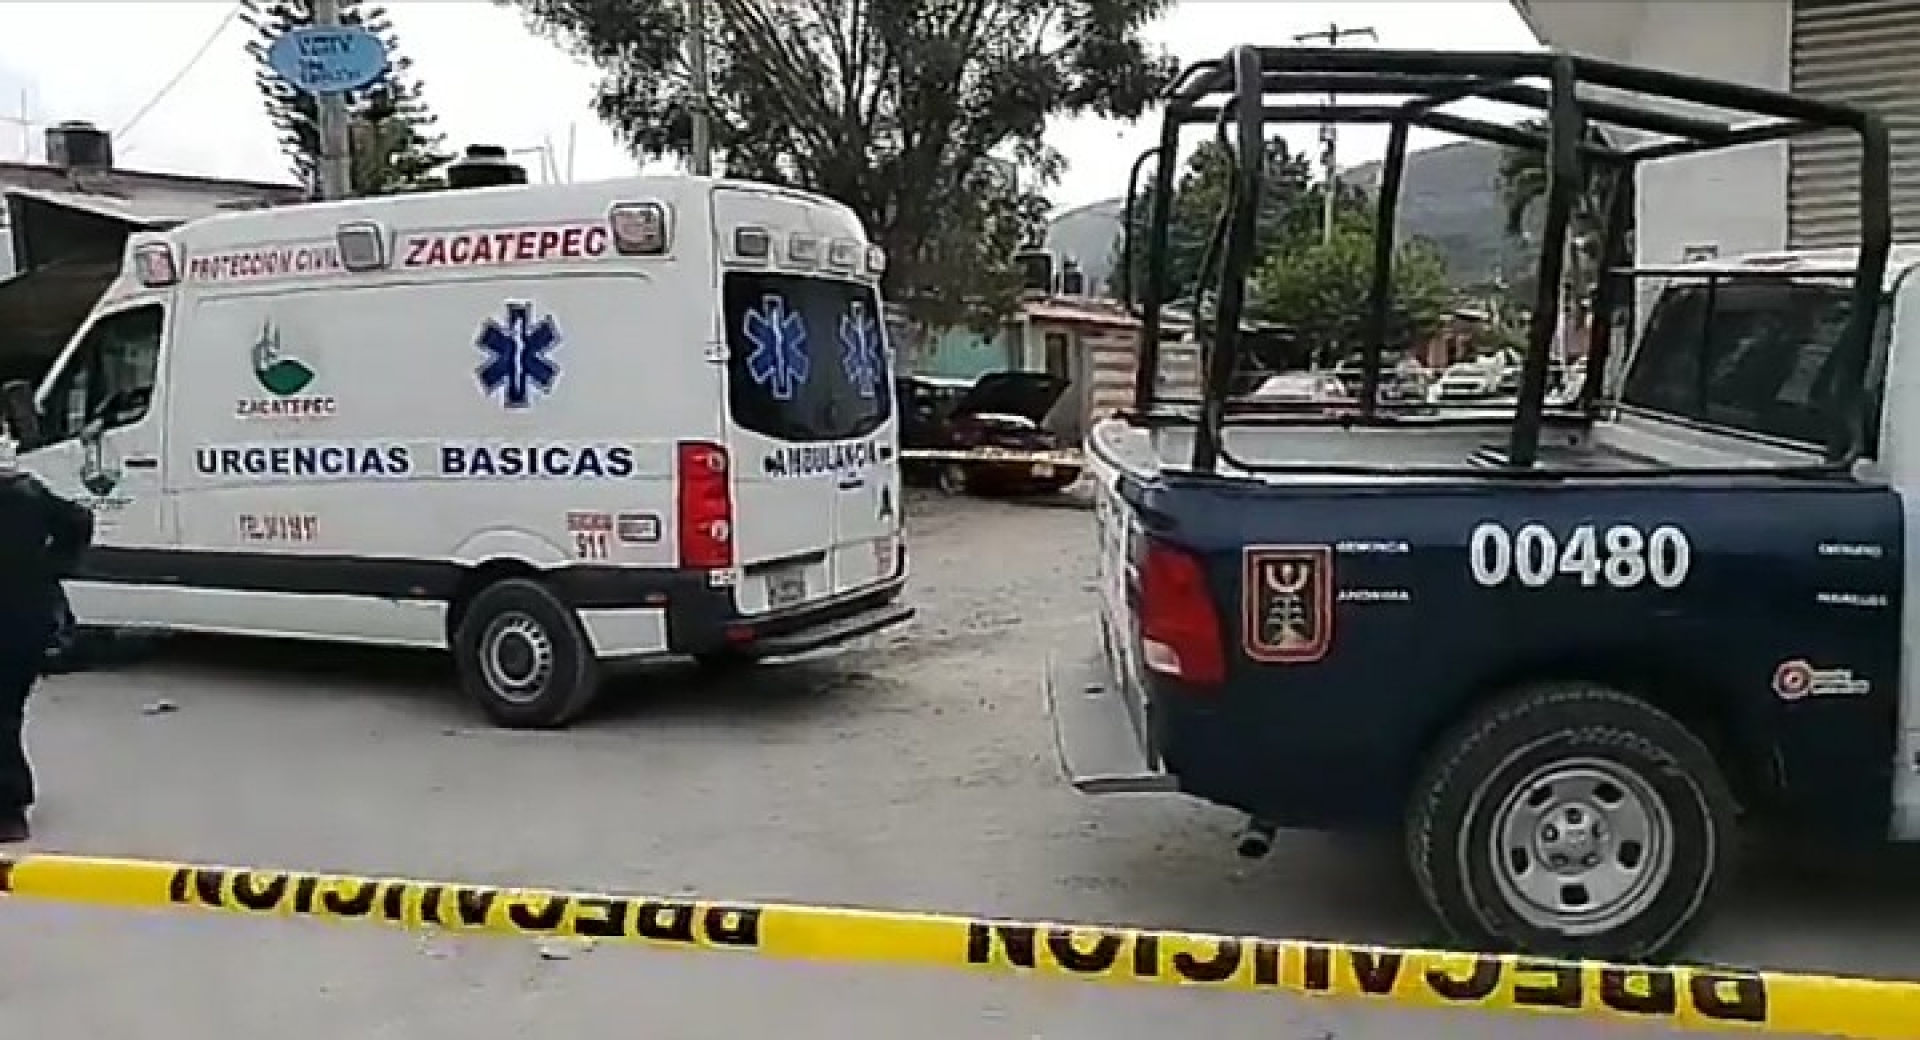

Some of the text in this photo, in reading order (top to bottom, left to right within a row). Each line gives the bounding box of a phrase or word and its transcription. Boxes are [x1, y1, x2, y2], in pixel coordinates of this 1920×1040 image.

[404, 226, 608, 267] ZACATEPEC
[236, 397, 336, 415] ZACATEPEC
[197, 447, 633, 476] URGENCIAS BASICAS
[576, 533, 607, 558] 911
[1470, 522, 1691, 588] 00480
